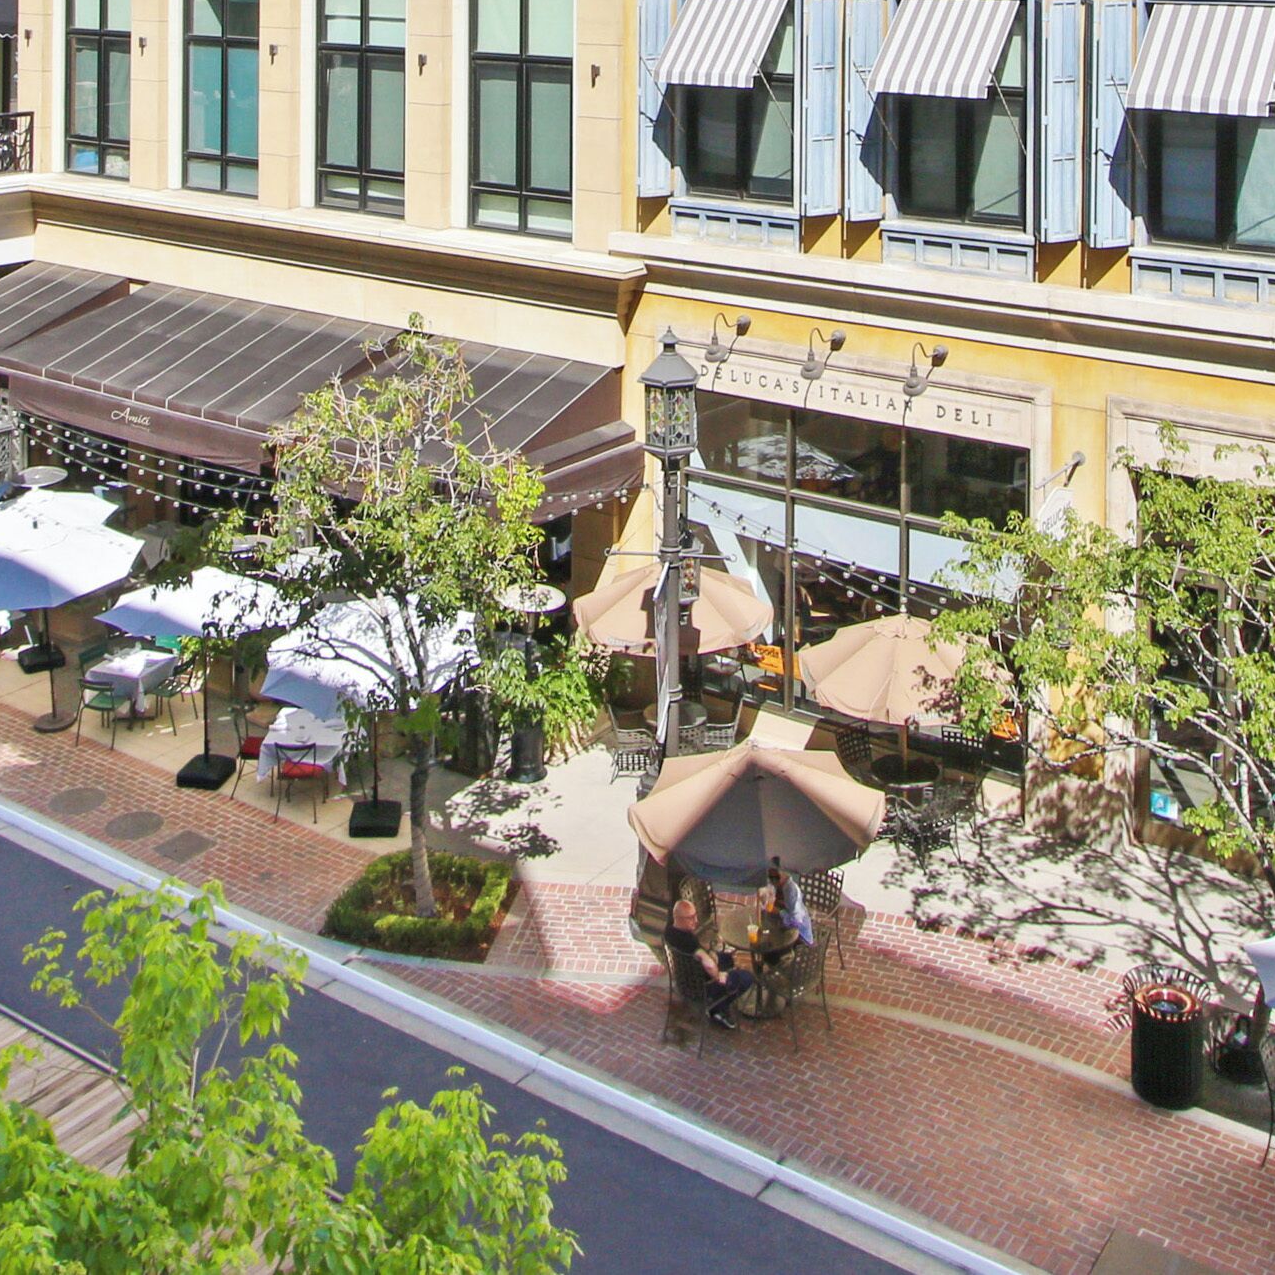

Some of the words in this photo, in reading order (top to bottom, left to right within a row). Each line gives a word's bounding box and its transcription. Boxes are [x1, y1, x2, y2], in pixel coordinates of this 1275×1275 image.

[700, 364, 800, 394] DELUCA'S
[819, 385, 913, 413] ITALIAN
[936, 404, 993, 427] DELI
[111, 407, 151, 425] Amici
